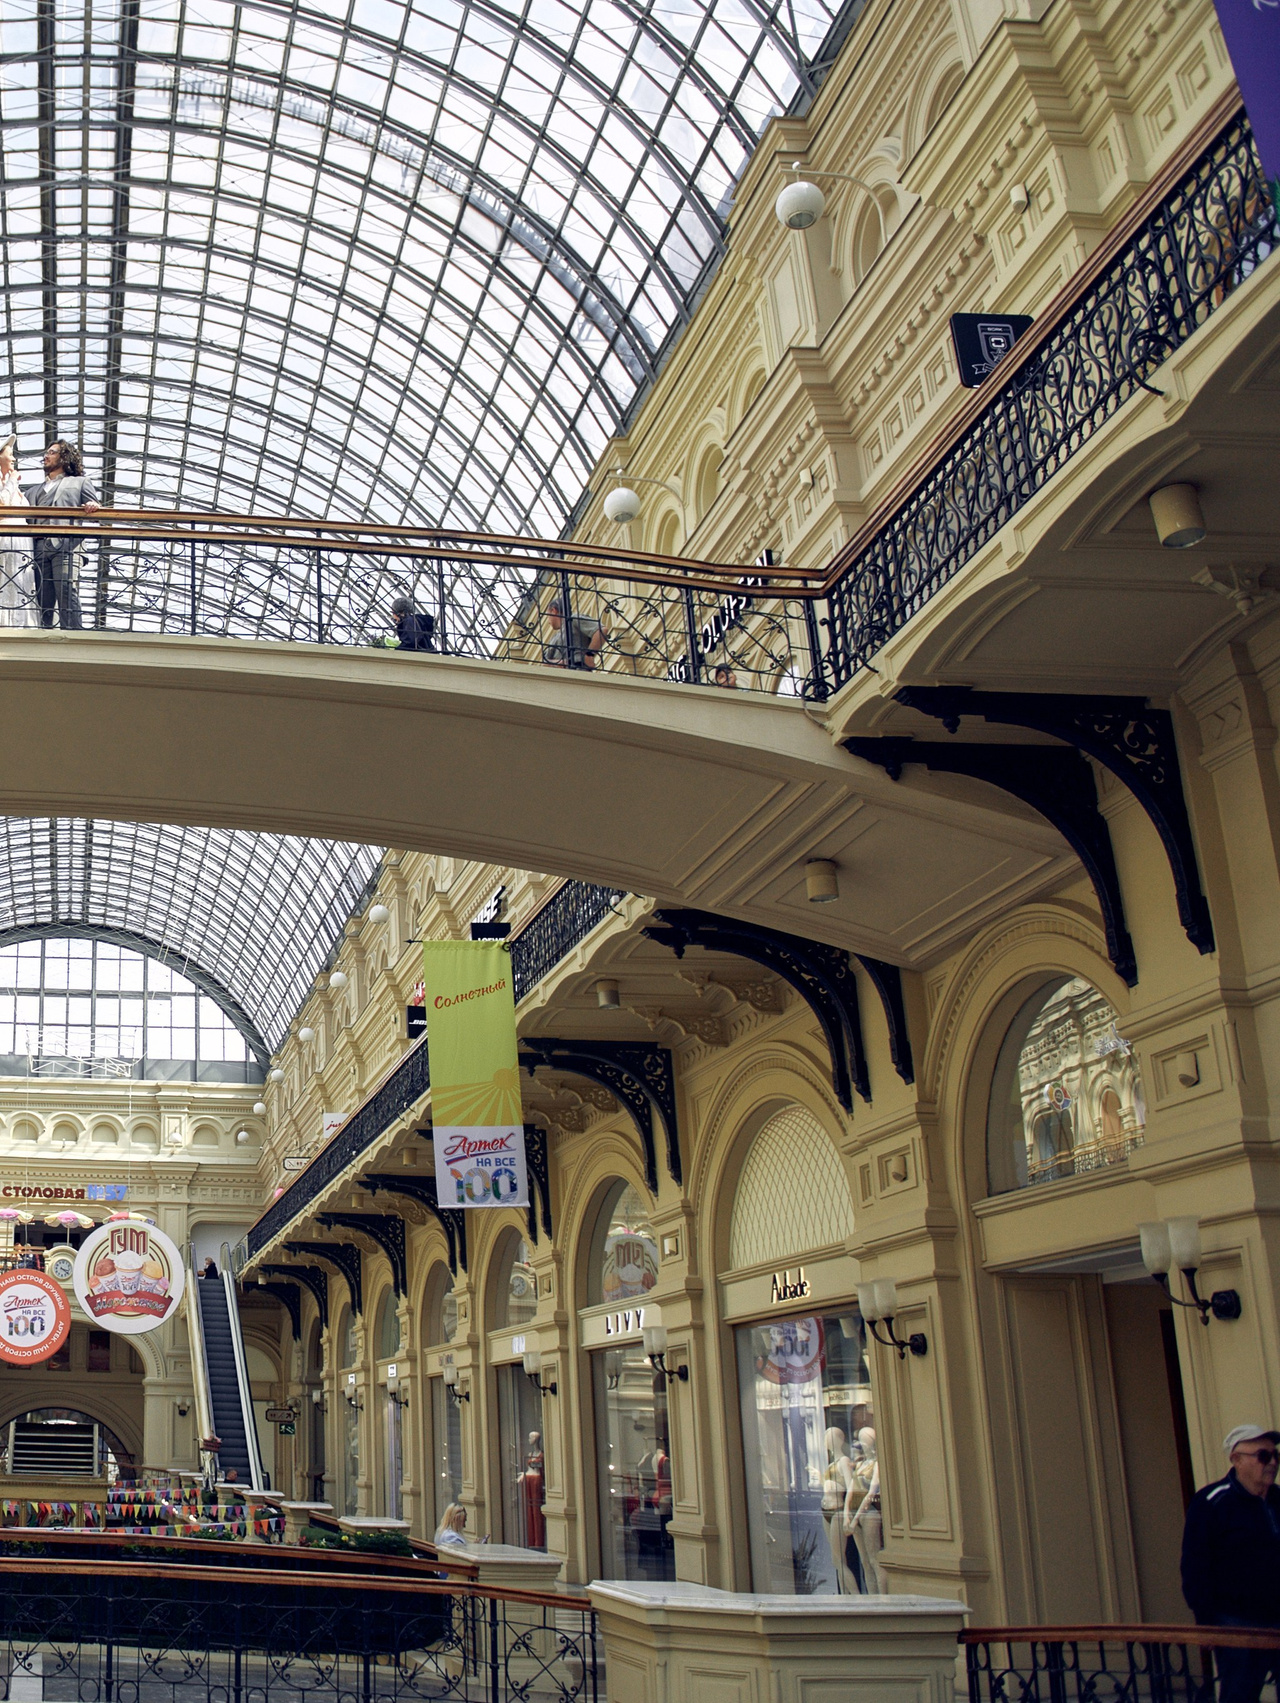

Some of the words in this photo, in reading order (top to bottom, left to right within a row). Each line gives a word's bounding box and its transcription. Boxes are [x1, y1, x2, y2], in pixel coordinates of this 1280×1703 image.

[434, 978, 507, 1010] Солнечный
[443, 1132, 515, 1158] Артек
[476, 1157, 492, 1167] НА
[495, 1157, 517, 1167] ВСЕ
[2, 1186, 85, 1199] СТОЛОВАЯ
[450, 1167, 518, 1204] 100
[110, 1227, 147, 1257] ГУМ
[0, 1276, 16, 1287] НАШ
[16, 1274, 44, 1284] ОСТРОВ
[770, 1267, 811, 1304] Aubade
[3, 1295, 47, 1309] Артек
[6, 1315, 45, 1337] 100
[51, 1320, 64, 1342] АРТЕК
[606, 1308, 645, 1335] LIVY
[4, 1347, 32, 1357] ОСТРОВ
[33, 1344, 49, 1355] НАШ
